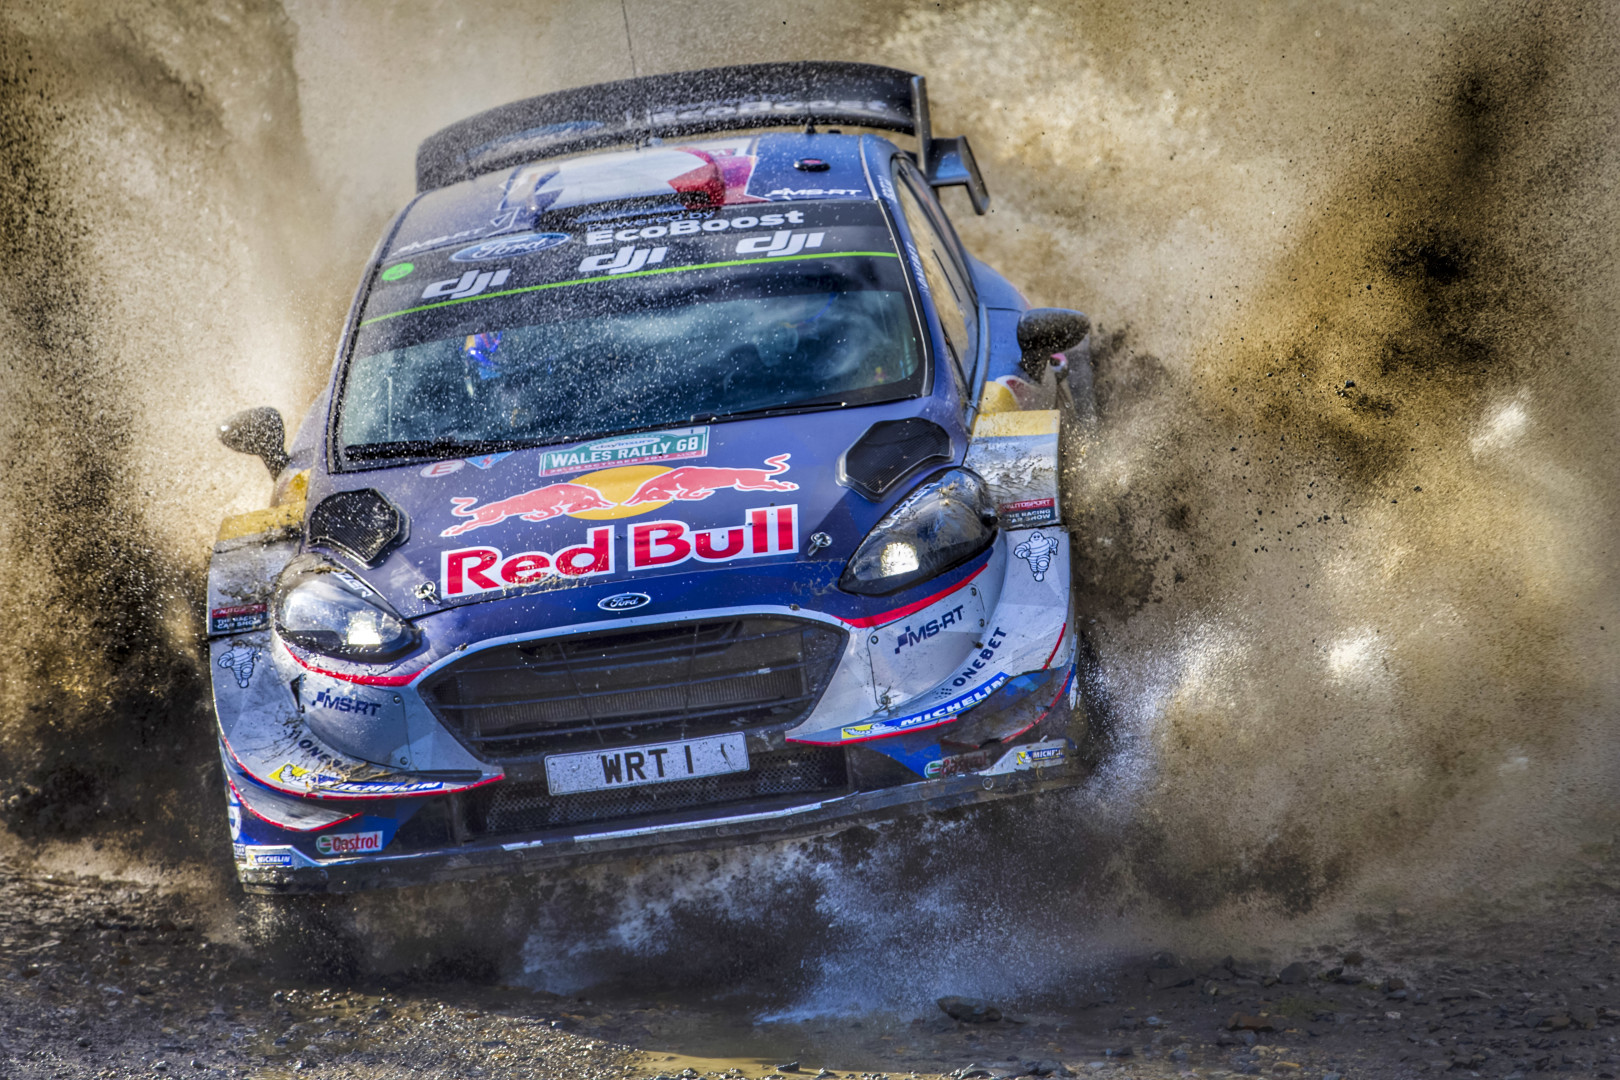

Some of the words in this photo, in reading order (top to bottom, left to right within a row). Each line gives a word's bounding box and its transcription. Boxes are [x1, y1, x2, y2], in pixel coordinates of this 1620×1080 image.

[586, 210, 805, 246] EcoBoost
[688, 210, 716, 220] by
[471, 236, 550, 259] Ford
[551, 450, 612, 468] WALES
[618, 441, 672, 460] RALLY
[676, 437, 699, 452] GB
[430, 462, 457, 475] E
[444, 528, 611, 596] Red
[632, 505, 796, 569] Bull
[610, 596, 639, 608] Ford
[908, 604, 964, 648] MS-RT
[952, 626, 1007, 687] ONEBET
[323, 694, 382, 717] MS-RT
[900, 676, 1006, 727] MICHELIN
[601, 747, 668, 785] WRT
[332, 834, 379, 851] Castrol
[257, 855, 291, 864] MICHELIN
